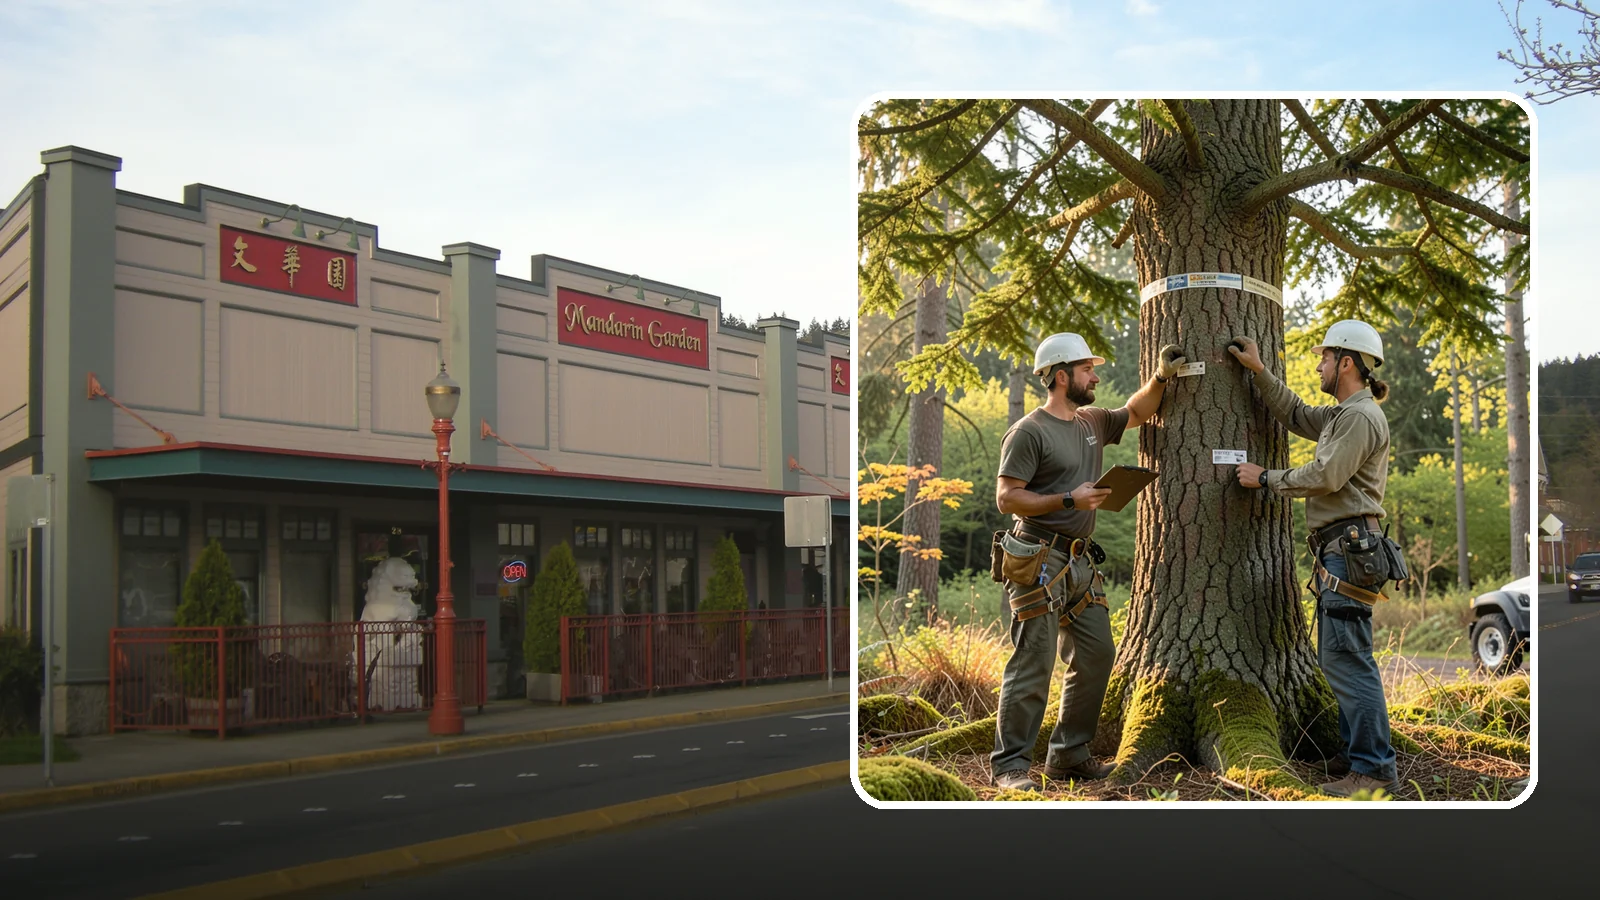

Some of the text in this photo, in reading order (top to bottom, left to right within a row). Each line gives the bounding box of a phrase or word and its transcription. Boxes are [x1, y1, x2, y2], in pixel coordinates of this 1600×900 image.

[230, 235, 346, 291] 文華園
[564, 302, 702, 352] Mandarin Garden
[503, 565, 527, 578] OPEN
